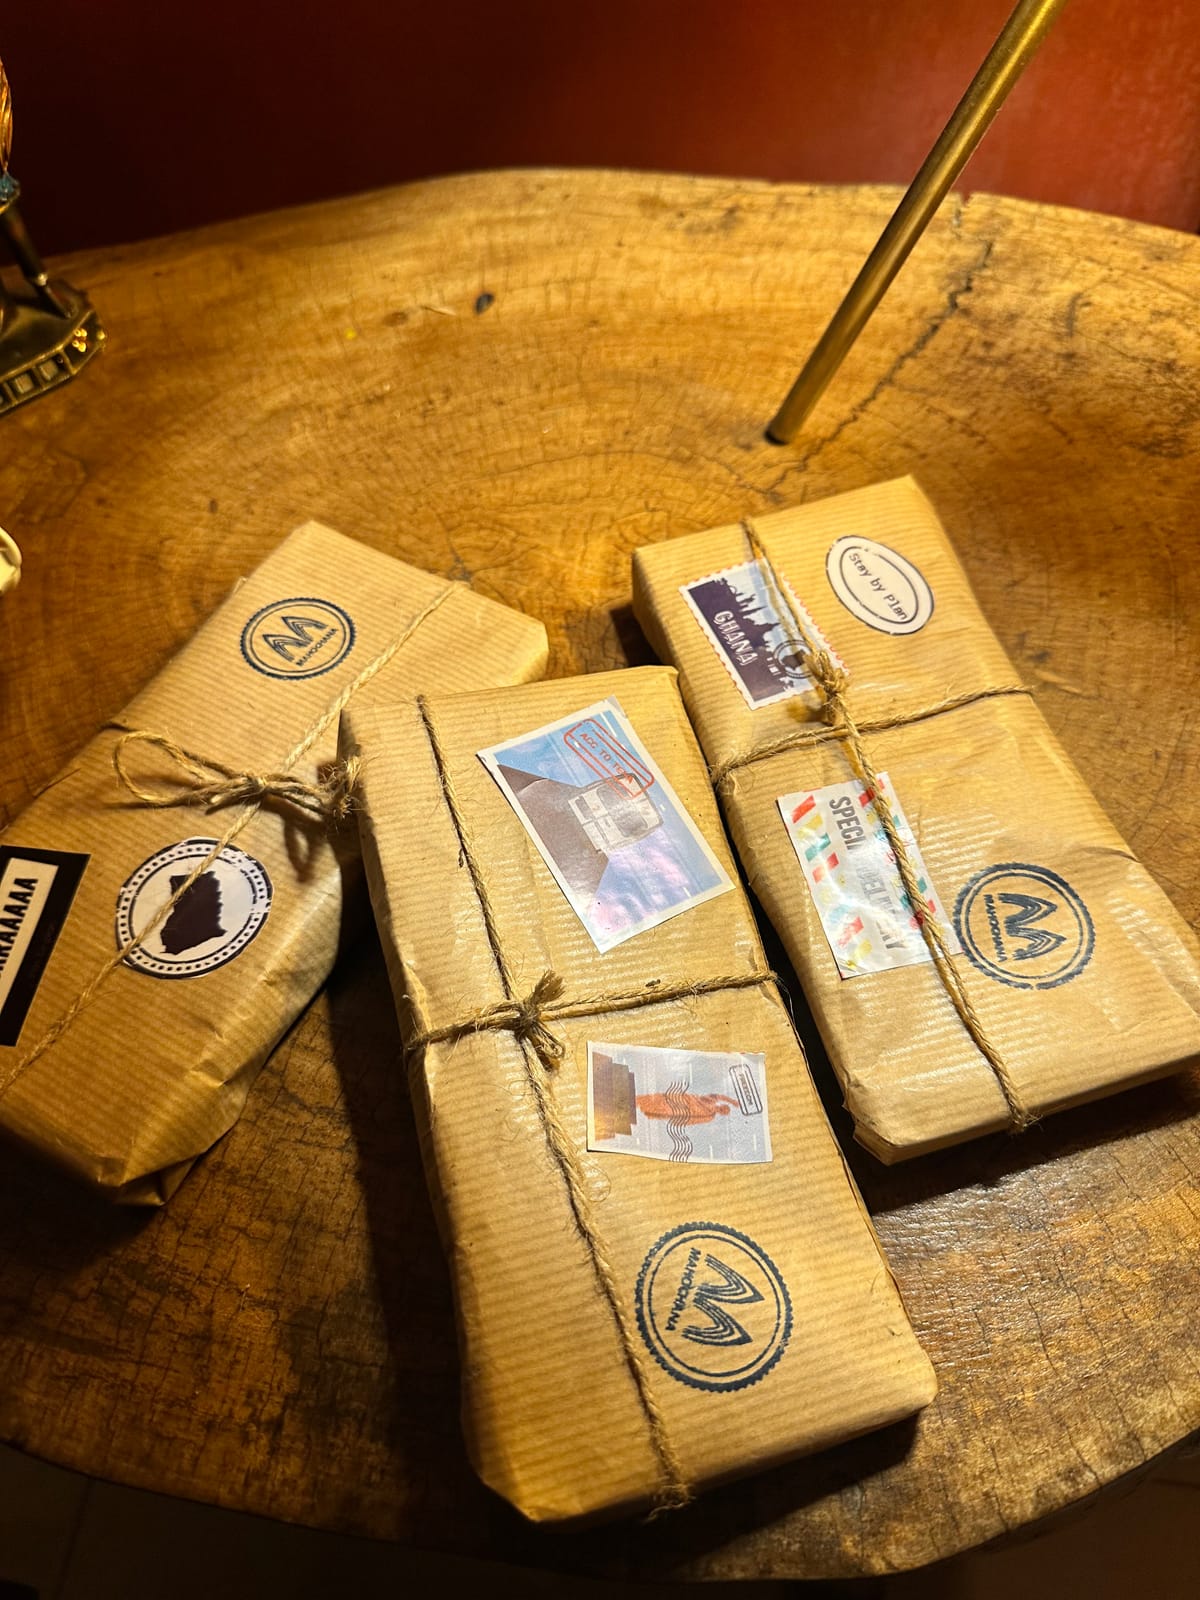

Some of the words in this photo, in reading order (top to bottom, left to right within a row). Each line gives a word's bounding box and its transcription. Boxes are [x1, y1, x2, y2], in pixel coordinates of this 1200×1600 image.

[849, 552, 872, 577] Stay
[869, 577, 886, 592] by
[884, 594, 908, 620] Plan
[713, 611, 757, 665] GHANA
[600, 748, 611, 761] TO
